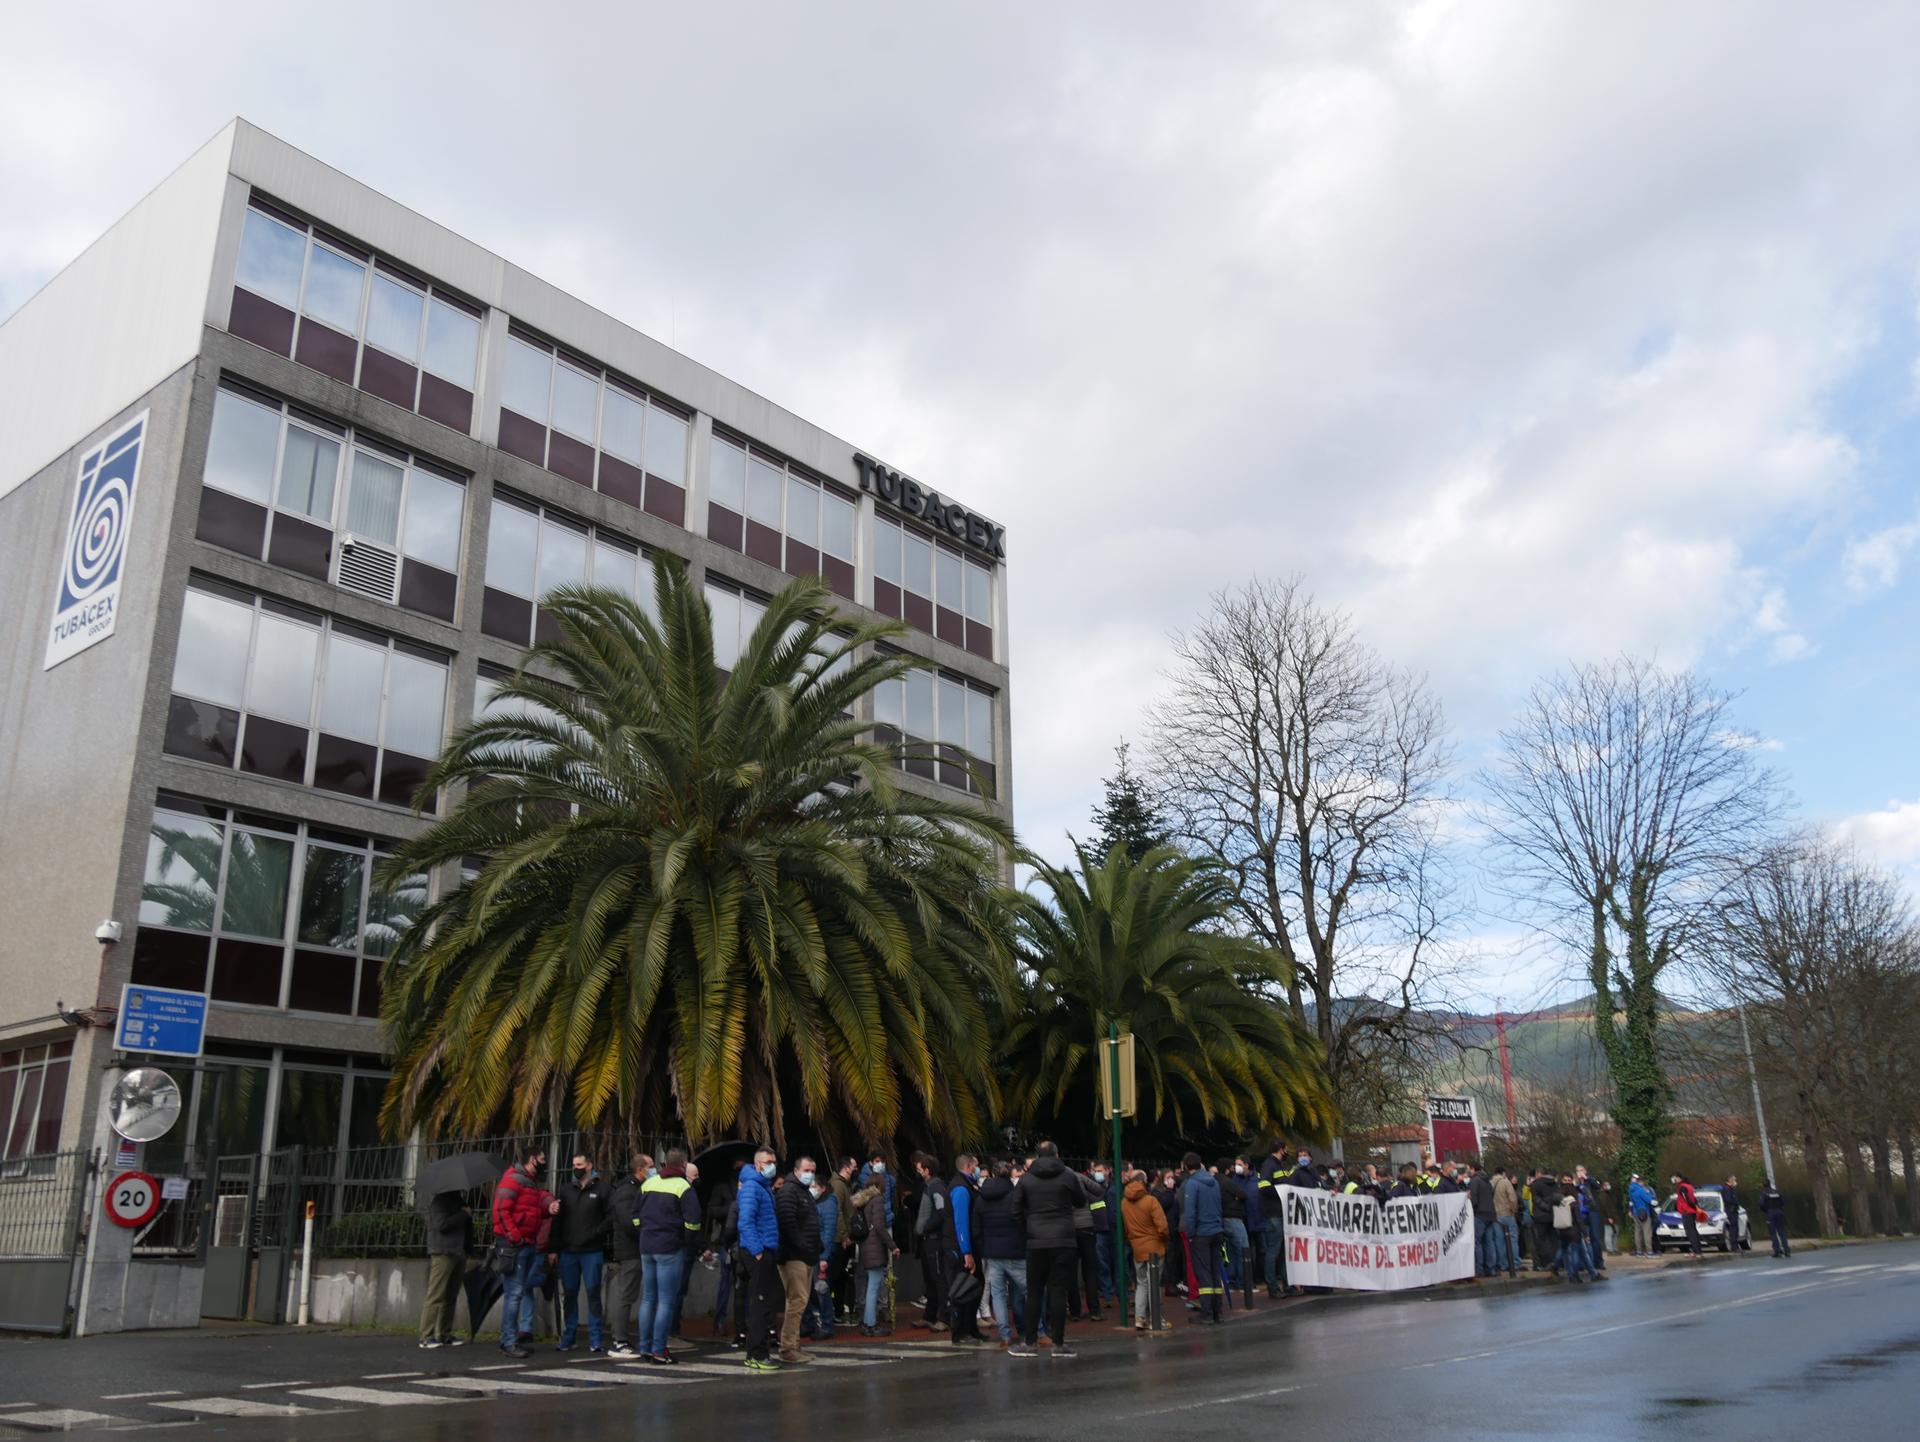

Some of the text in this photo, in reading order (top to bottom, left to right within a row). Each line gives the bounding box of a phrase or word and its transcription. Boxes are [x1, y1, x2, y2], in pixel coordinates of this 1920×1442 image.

[853, 452, 1005, 558] TUBACEX
[1429, 1100, 1472, 1118] SE ALQUILA
[119, 1190, 146, 1207] 20
[1379, 1202, 1440, 1235] EFENTSAN
[1288, 1236, 1309, 1262] EN
[1317, 1238, 1370, 1269] DEFENSA
[1397, 1240, 1439, 1268] EMPLEO
